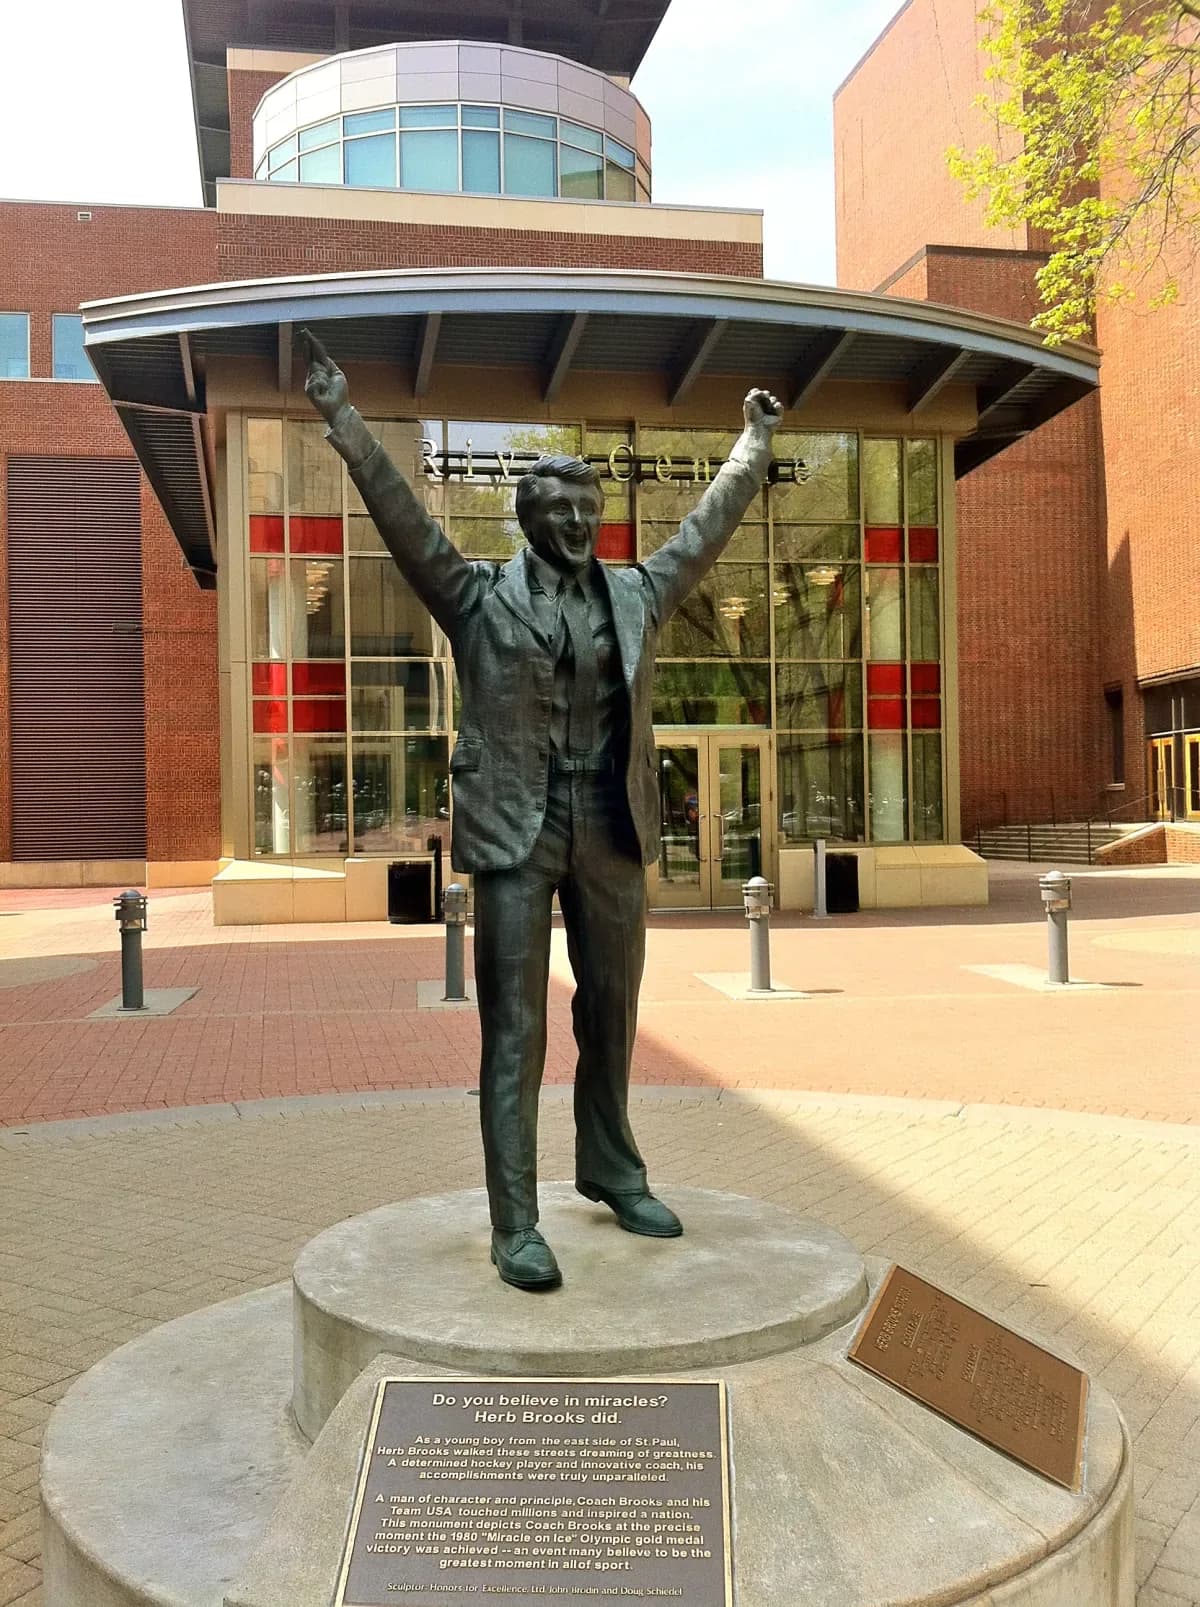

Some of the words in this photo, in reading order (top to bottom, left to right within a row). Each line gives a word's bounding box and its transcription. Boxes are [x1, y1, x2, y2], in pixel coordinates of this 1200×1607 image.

[433, 1394, 456, 1405] Do
[462, 1396, 493, 1409] you
[499, 1395, 558, 1406] believe
[565, 1395, 579, 1406] in
[585, 1395, 668, 1407] miracles?
[475, 1411, 516, 1423] Herb
[522, 1411, 585, 1424] Brooks
[591, 1412, 622, 1424] did.
[415, 1436, 430, 1444] As
[444, 1437, 479, 1446] young
[483, 1436, 504, 1446] boy
[509, 1436, 536, 1445] from
[542, 1437, 560, 1445] the
[564, 1437, 589, 1446] east
[592, 1438, 616, 1446] side
[620, 1438, 632, 1446] of
[377, 1446, 404, 1455] Herb
[408, 1447, 449, 1456] Brooks
[453, 1447, 493, 1456] walked
[497, 1448, 530, 1456] these
[534, 1449, 576, 1457] streets
[579, 1449, 634, 1459] dreaming
[637, 1450, 650, 1458] of
[653, 1450, 717, 1459] greatness.
[387, 1458, 397, 1467] A
[401, 1458, 467, 1467] determined
[470, 1459, 512, 1469] hockey
[516, 1460, 553, 1470] player
[556, 1460, 578, 1469] and
[581, 1460, 642, 1469] innovative
[645, 1461, 684, 1471] coach,
[686, 1462, 704, 1470] his
[419, 1471, 524, 1481] accomplishments
[527, 1473, 556, 1481] were
[560, 1472, 588, 1483] truly
[375, 1494, 384, 1503] A
[390, 1495, 415, 1504] man
[418, 1494, 432, 1504] of
[433, 1495, 491, 1504] character
[494, 1495, 517, 1505] and
[520, 1496, 576, 1506] principle,
[577, 1496, 616, 1506] Coach
[619, 1497, 663, 1507] Brooks
[666, 1498, 689, 1507] and
[692, 1498, 710, 1507] his
[390, 1506, 421, 1515] Team
[426, 1507, 452, 1516] USA
[458, 1507, 508, 1517] touched
[511, 1508, 557, 1517] millions
[561, 1509, 584, 1518] and
[587, 1509, 636, 1520] inspired
[640, 1511, 647, 1519] a
[651, 1510, 694, 1519] nation.
[381, 1518, 406, 1528] This
[409, 1519, 473, 1529] monument
[475, 1520, 521, 1531] depicts
[525, 1521, 565, 1530] Coach
[567, 1521, 612, 1531] Brooks
[615, 1522, 628, 1531] at
[630, 1522, 650, 1531] the
[654, 1523, 701, 1533] precise
[375, 1532, 425, 1541] moment
[427, 1532, 447, 1541] the
[450, 1532, 478, 1541] 1980
[481, 1532, 531, 1542] "Miracle
[534, 1534, 550, 1543] on
[553, 1534, 577, 1543] Ice"
[580, 1534, 631, 1545] Olympic
[635, 1535, 663, 1546] gold
[666, 1535, 704, 1545] medal
[366, 1544, 411, 1555] victory
[415, 1546, 440, 1554] was
[443, 1545, 498, 1555] achieved
[513, 1547, 529, 1555] an
[532, 1547, 566, 1556] event
[569, 1549, 601, 1558] many
[606, 1548, 651, 1557] believe
[655, 1549, 667, 1558] to
[672, 1548, 687, 1558] be
[691, 1548, 712, 1558] the
[439, 1559, 492, 1569] greatest
[495, 1560, 545, 1569] moment
[548, 1560, 559, 1569] in
[578, 1560, 592, 1570] of
[594, 1561, 633, 1572] sport.
[465, 1584, 479, 1592] for
[548, 1585, 568, 1594] John
[601, 1587, 618, 1595] and
[620, 1587, 644, 1596] Doug
